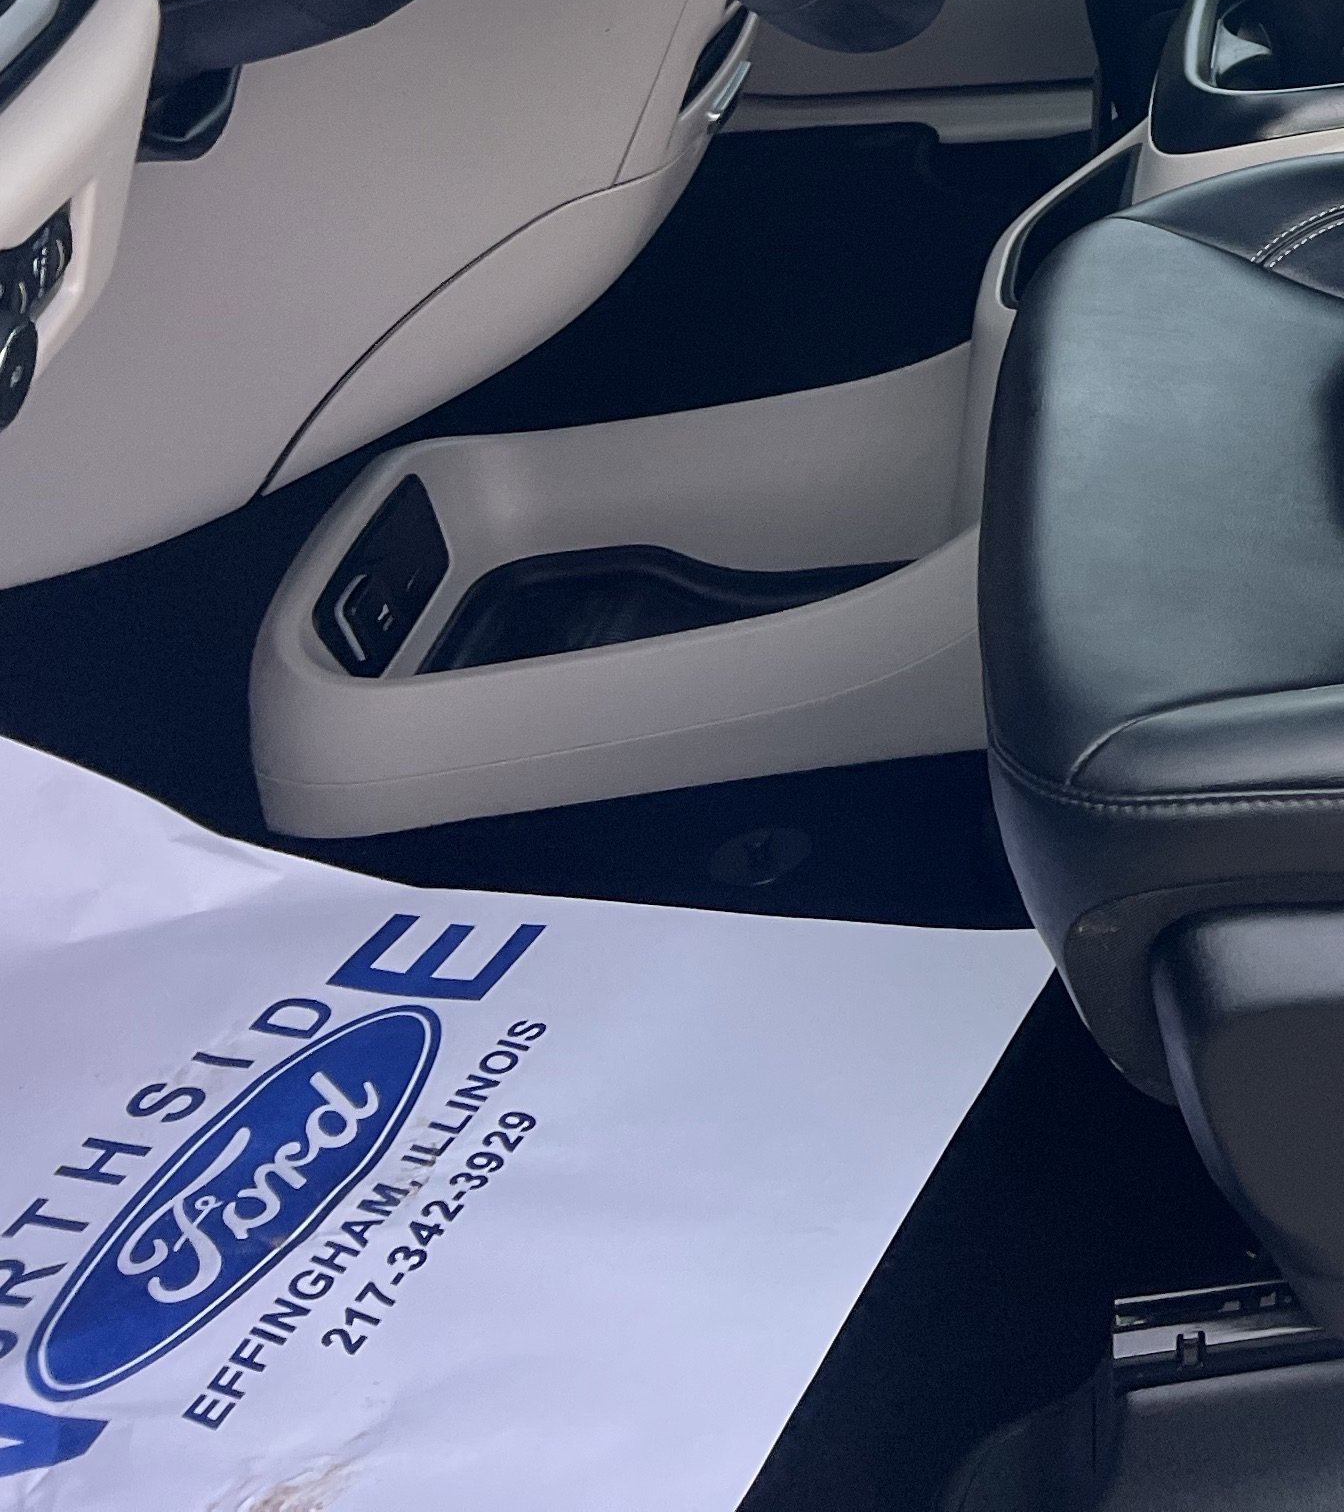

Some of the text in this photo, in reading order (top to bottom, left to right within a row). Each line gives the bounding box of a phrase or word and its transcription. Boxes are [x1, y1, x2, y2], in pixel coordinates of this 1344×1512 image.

[117, 1071, 379, 1303] Ford
[182, 1019, 547, 1431] EFFINGHAM, ILLINOIS
[321, 1111, 537, 1356] 217-342-3929
